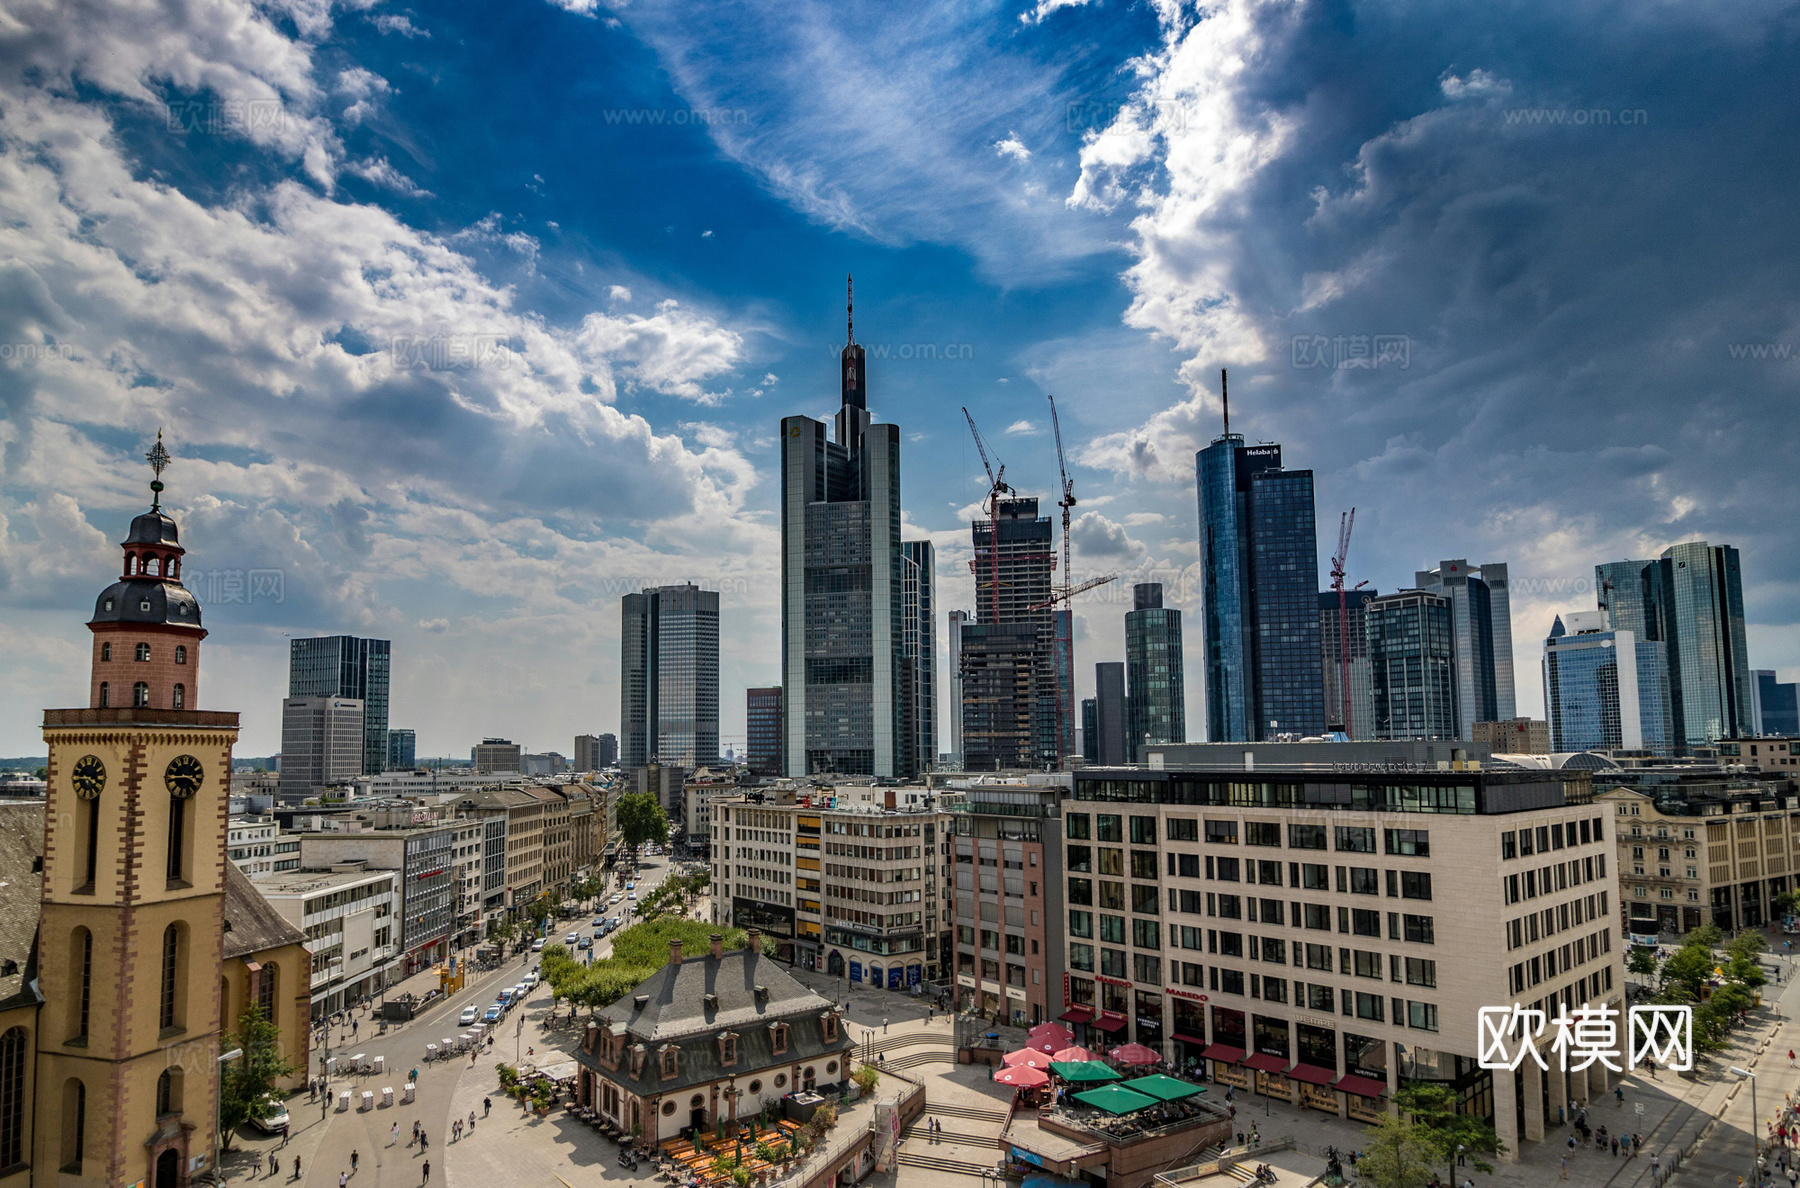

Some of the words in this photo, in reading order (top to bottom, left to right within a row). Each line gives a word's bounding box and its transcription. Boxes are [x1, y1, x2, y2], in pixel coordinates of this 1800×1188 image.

[1095, 975, 1133, 989] MAREDO
[1166, 987, 1209, 1002] MAREDO
[1137, 1017, 1160, 1027] STARBUCKS
[1292, 1013, 1336, 1029] WEMPE
[1261, 1047, 1283, 1056] WEMPE
[1354, 1068, 1379, 1078] WEMPE
